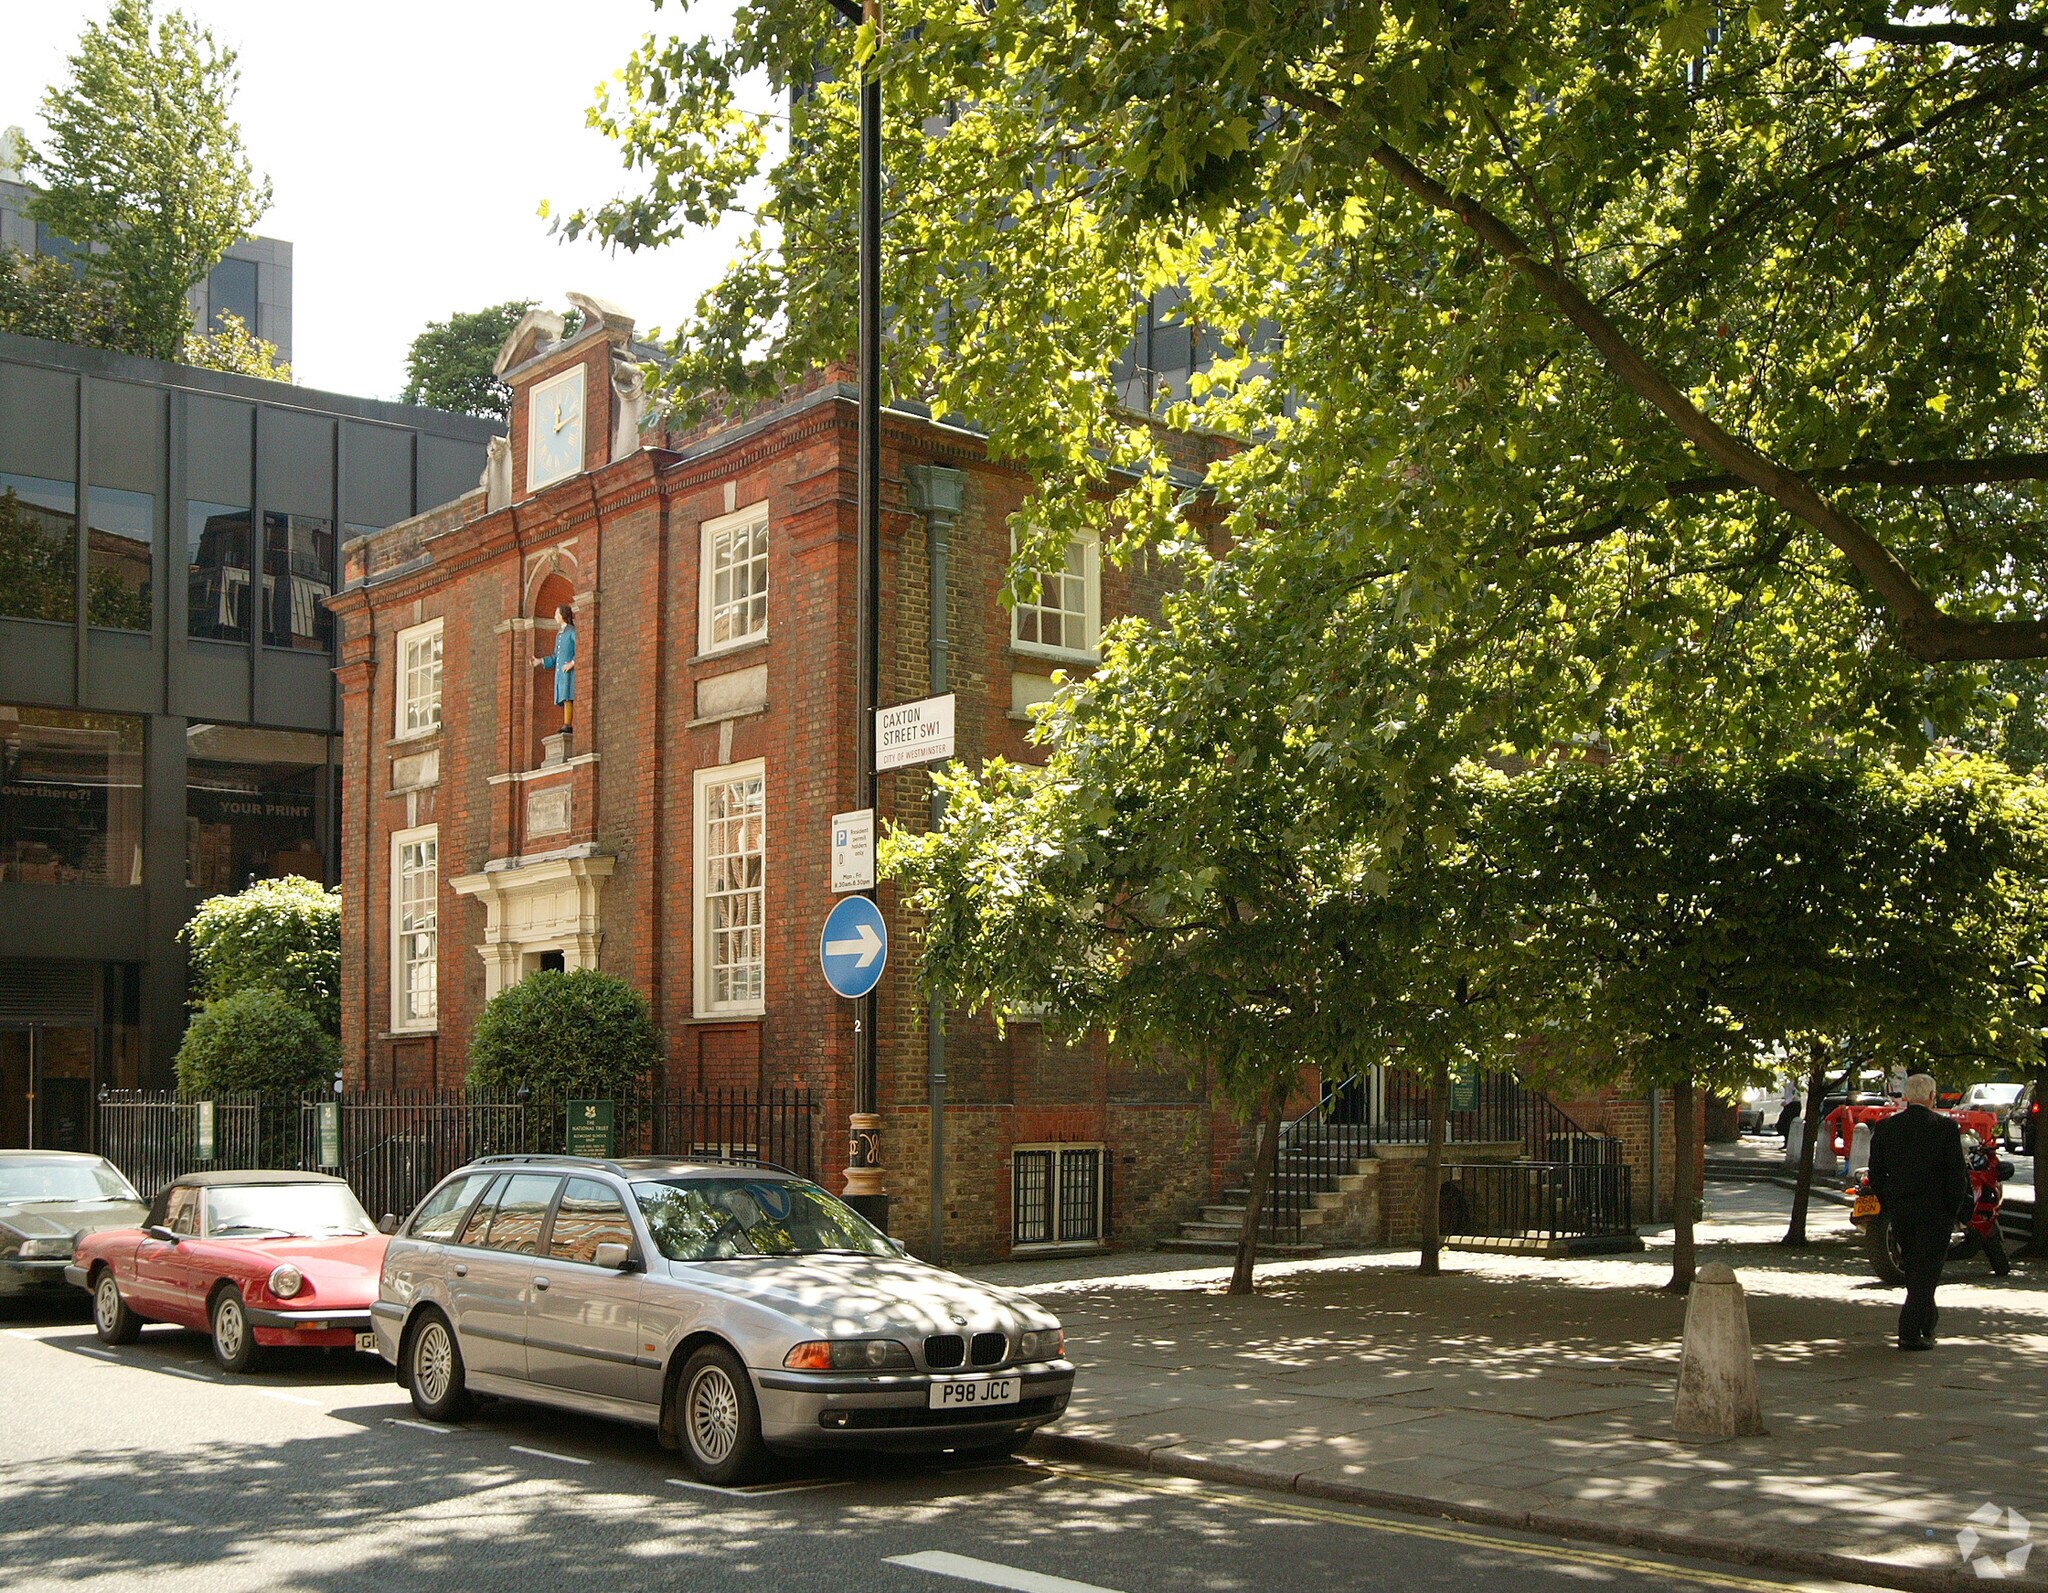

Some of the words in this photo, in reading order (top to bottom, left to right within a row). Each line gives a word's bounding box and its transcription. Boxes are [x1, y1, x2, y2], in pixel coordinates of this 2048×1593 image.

[883, 707, 921, 729] CAXTON
[883, 725, 918, 746] STREET
[920, 721, 940, 738] SW1
[883, 753, 896, 765] CITY
[897, 751, 904, 762] OF
[906, 743, 947, 760] WESTMINSTER
[219, 801, 262, 815] YOUR
[266, 804, 310, 817] PRINT
[838, 831, 846, 846] P
[854, 1019, 862, 1032] 2
[943, 1384, 976, 1403] P98
[980, 1381, 1010, 1401] JCC
